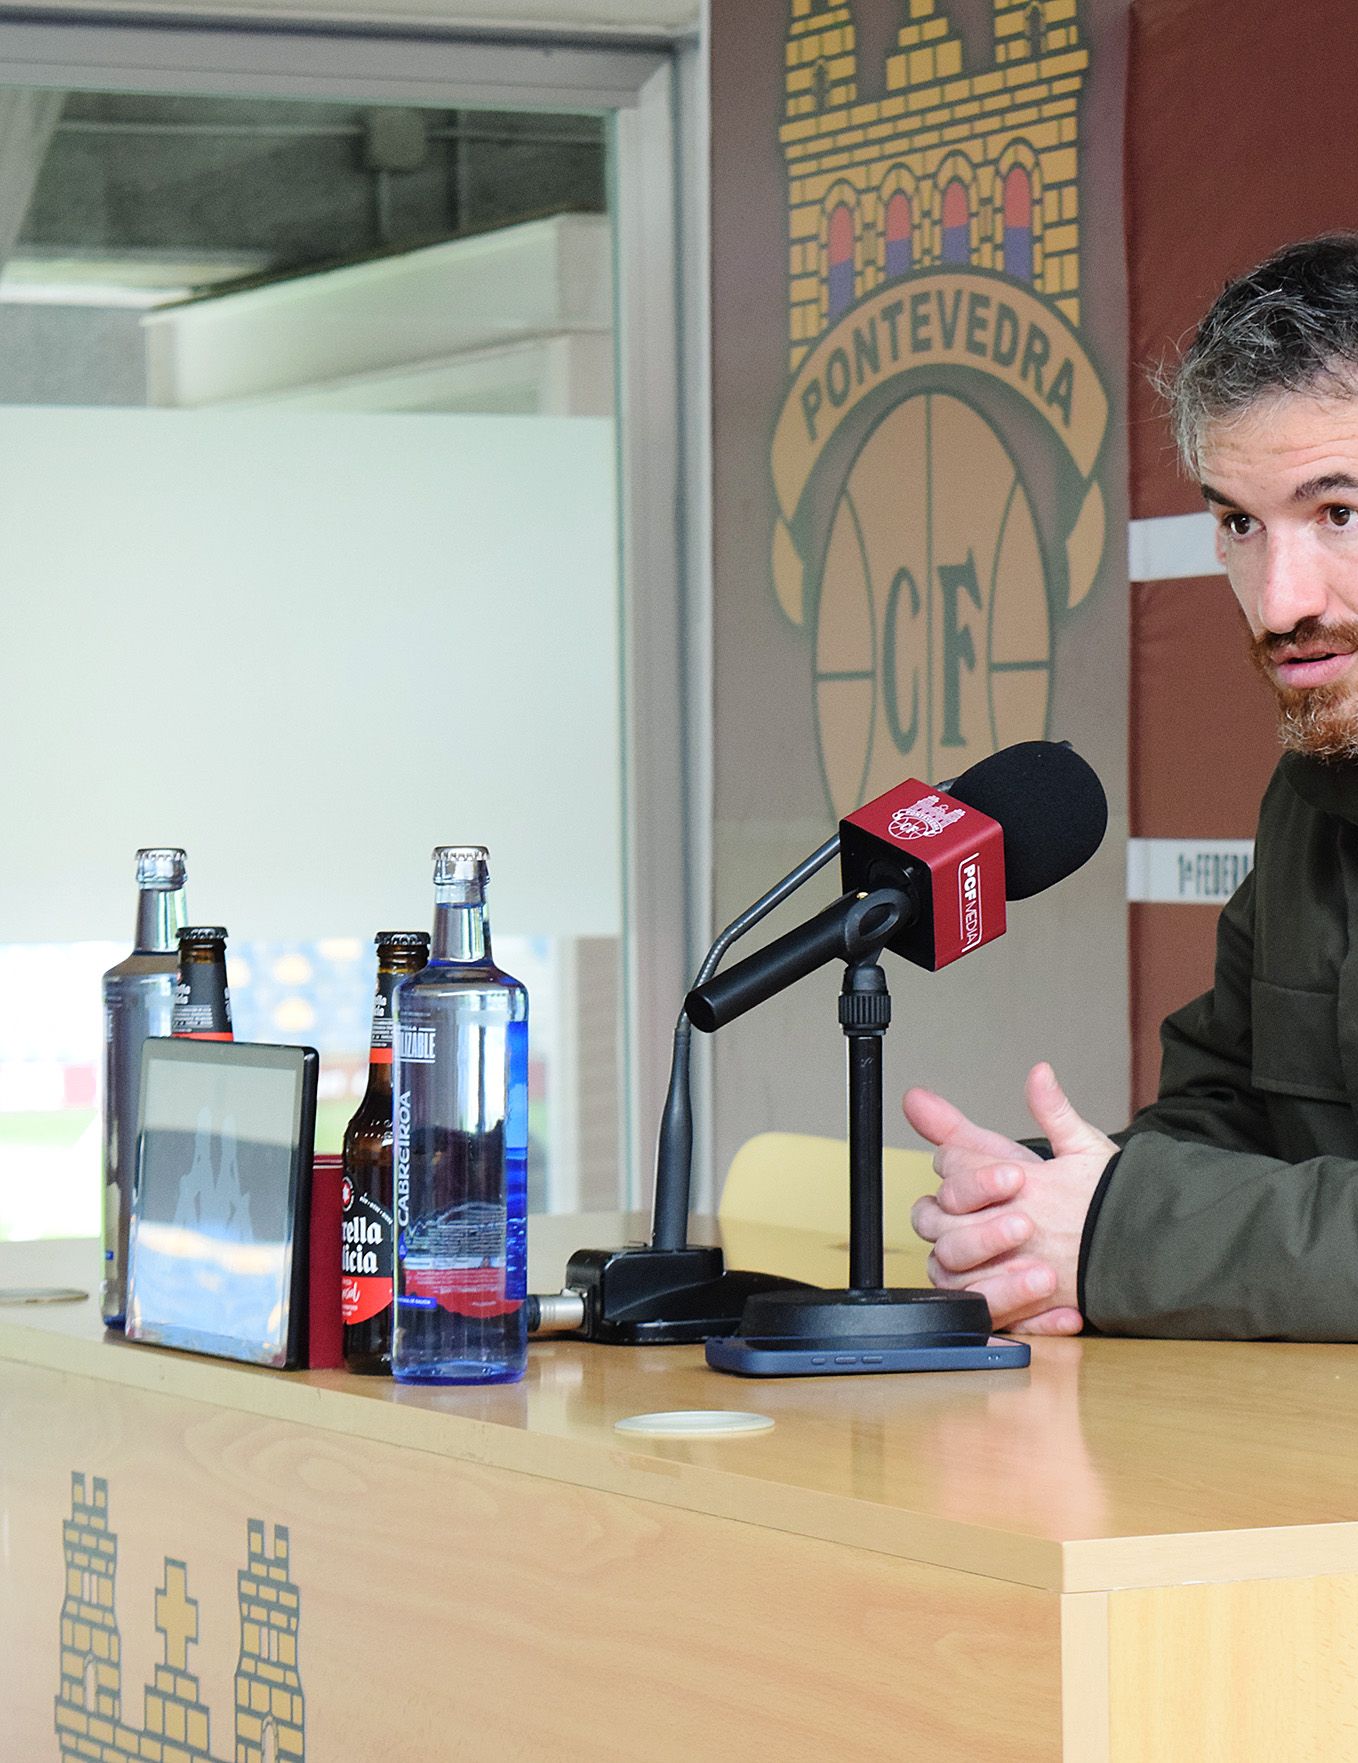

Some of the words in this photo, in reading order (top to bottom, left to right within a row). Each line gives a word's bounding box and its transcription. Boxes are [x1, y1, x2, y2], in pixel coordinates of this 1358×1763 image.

[799, 289, 1077, 440] PONTEVEDRA
[883, 545, 984, 754] CF
[398, 1090, 411, 1226] CABREIROA
